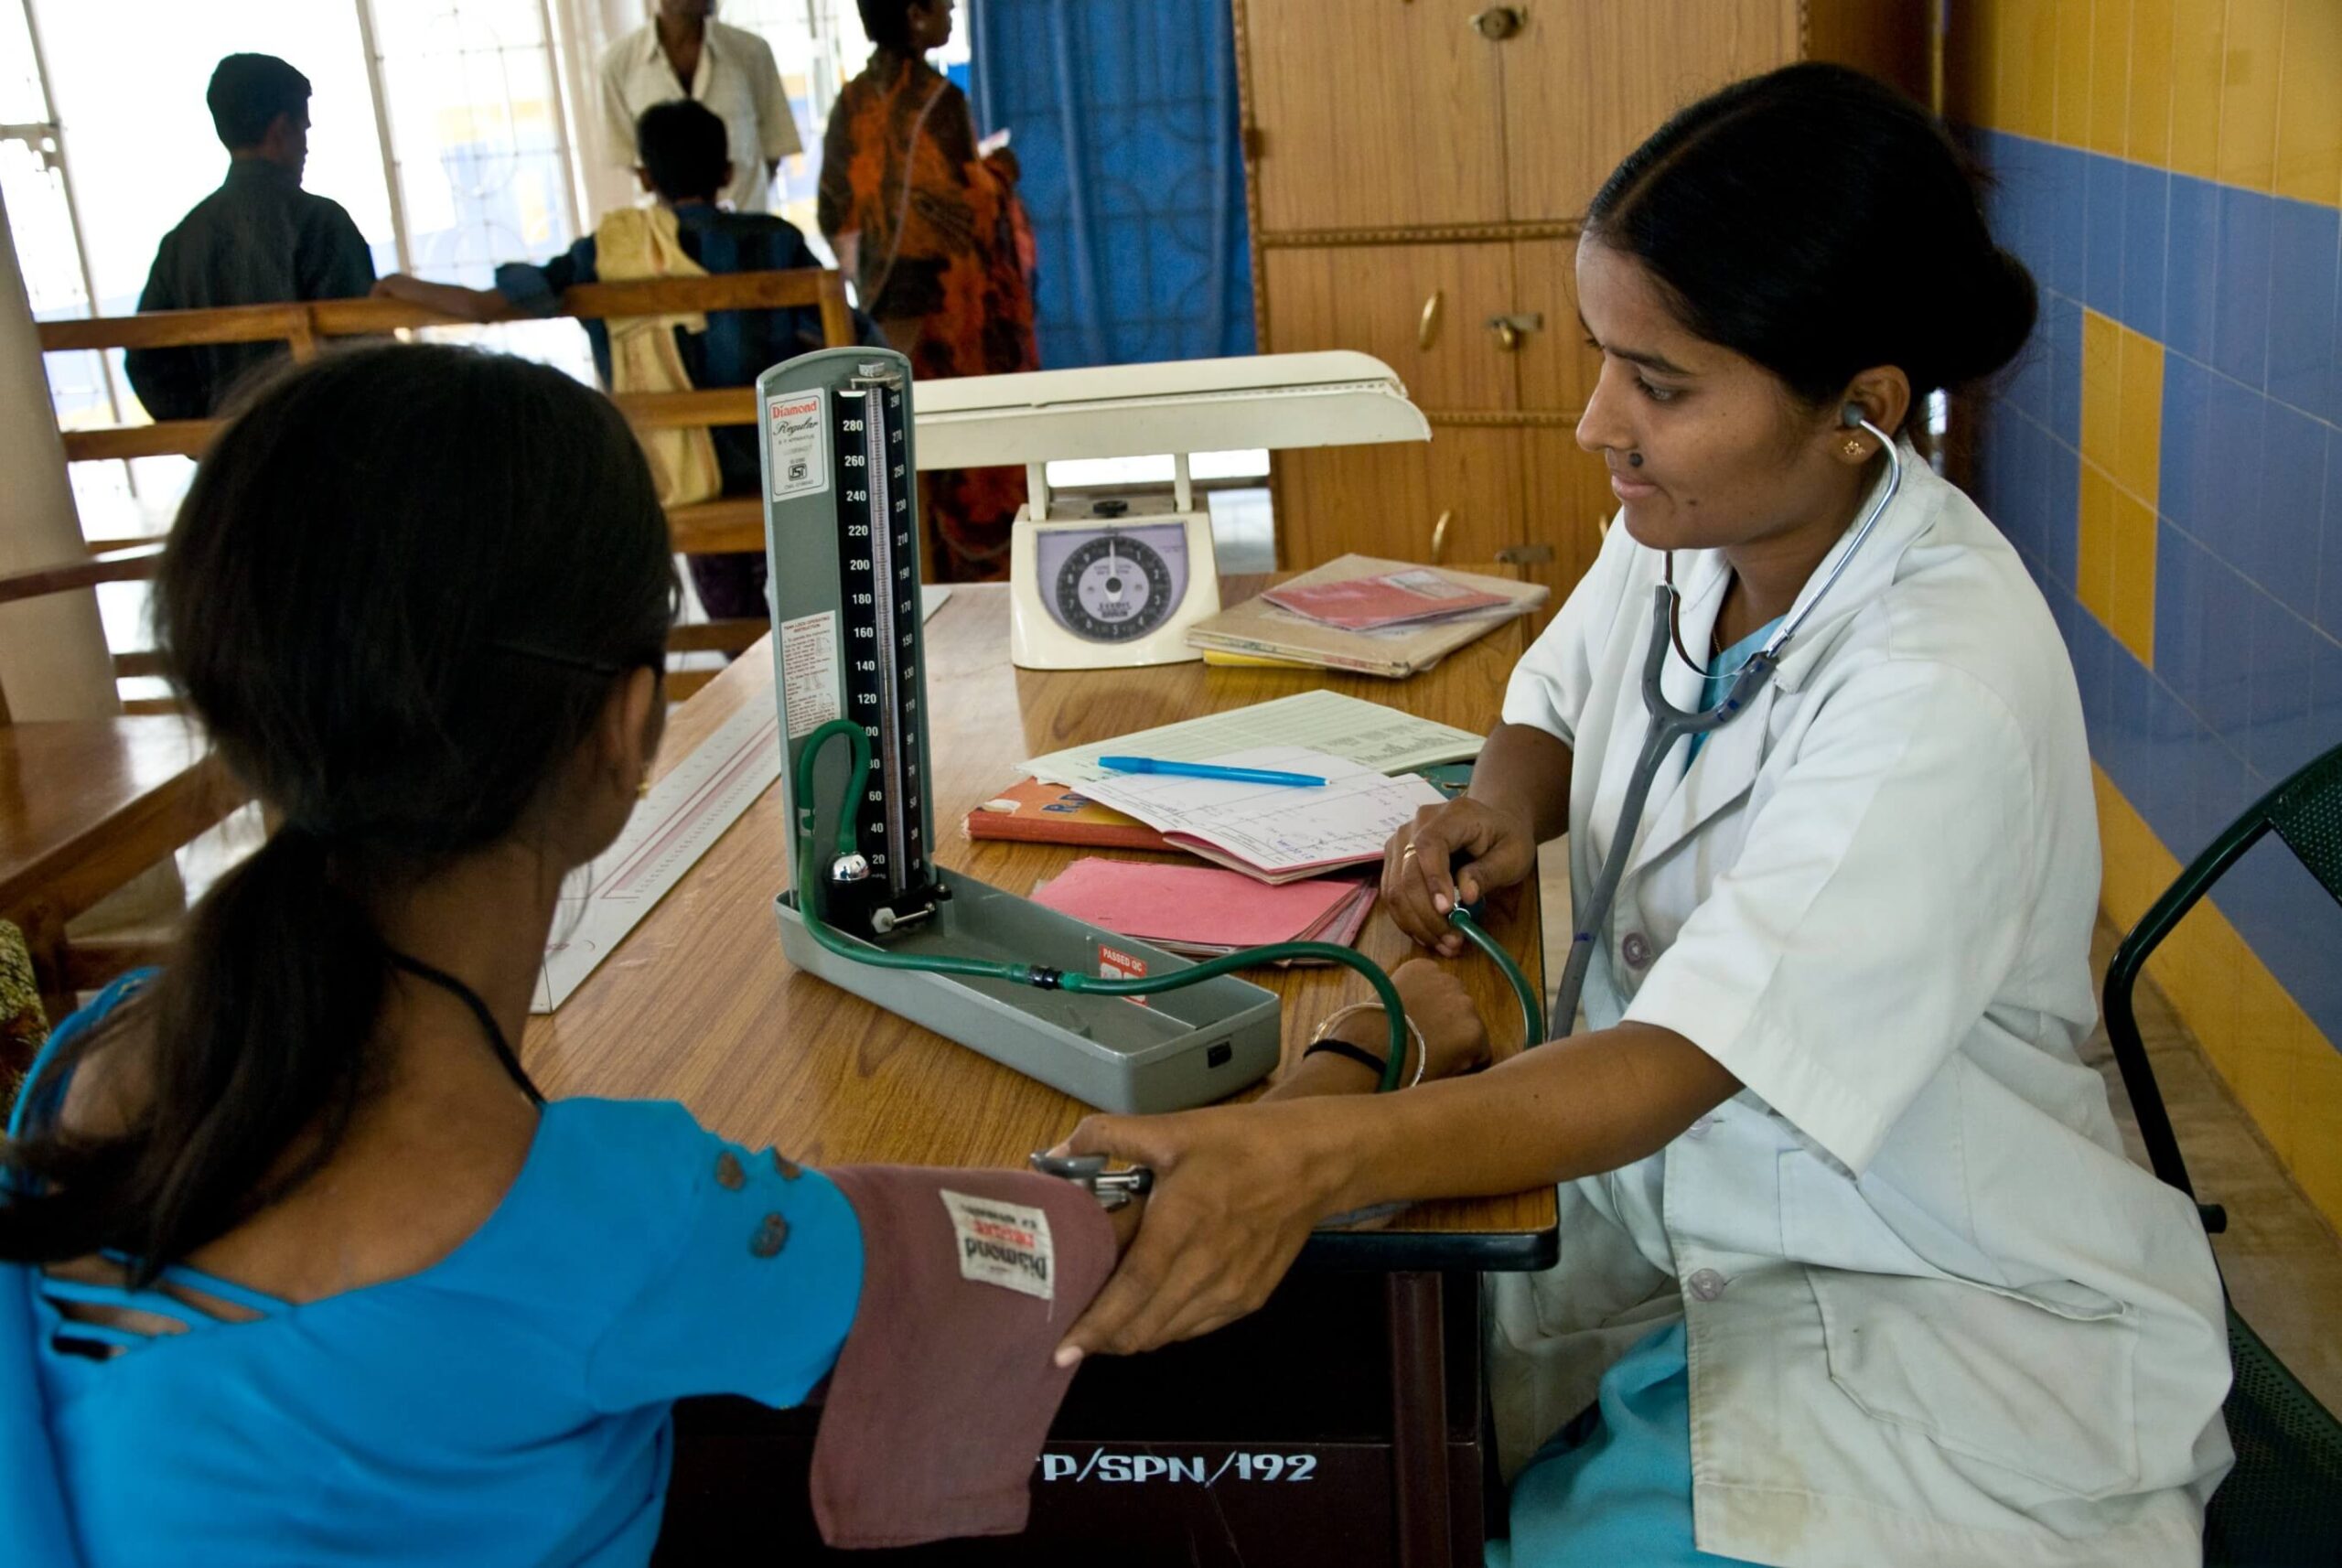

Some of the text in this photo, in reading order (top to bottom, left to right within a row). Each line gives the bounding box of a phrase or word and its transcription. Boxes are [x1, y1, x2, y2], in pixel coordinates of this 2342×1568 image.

[772, 401, 817, 419] Diamond
[773, 416, 819, 437] Regular
[843, 420, 864, 432] 280
[892, 430, 903, 444] 270
[844, 455, 865, 467] 260
[894, 465, 905, 478] 250
[846, 489, 866, 502] 240
[896, 499, 907, 512] 230
[848, 524, 868, 537] 220
[897, 532, 908, 546] 210
[850, 559, 870, 571] 200
[899, 567, 910, 581] 190
[852, 593, 872, 605] 180
[900, 600, 912, 614] 170
[854, 627, 874, 639] 160
[902, 633, 913, 647] 150
[855, 660, 876, 671] 140
[904, 666, 915, 680] 130
[857, 693, 877, 704] 120
[905, 699, 916, 712] 110
[862, 725, 879, 736] 00
[868, 790, 883, 801] 60
[870, 822, 885, 833] 40
[872, 854, 886, 865] 20
[1103, 948, 1143, 972] PASSED QC
[965, 1236, 1047, 1281] Diamond
[1036, 1445, 1318, 1488] P/SPN/192
